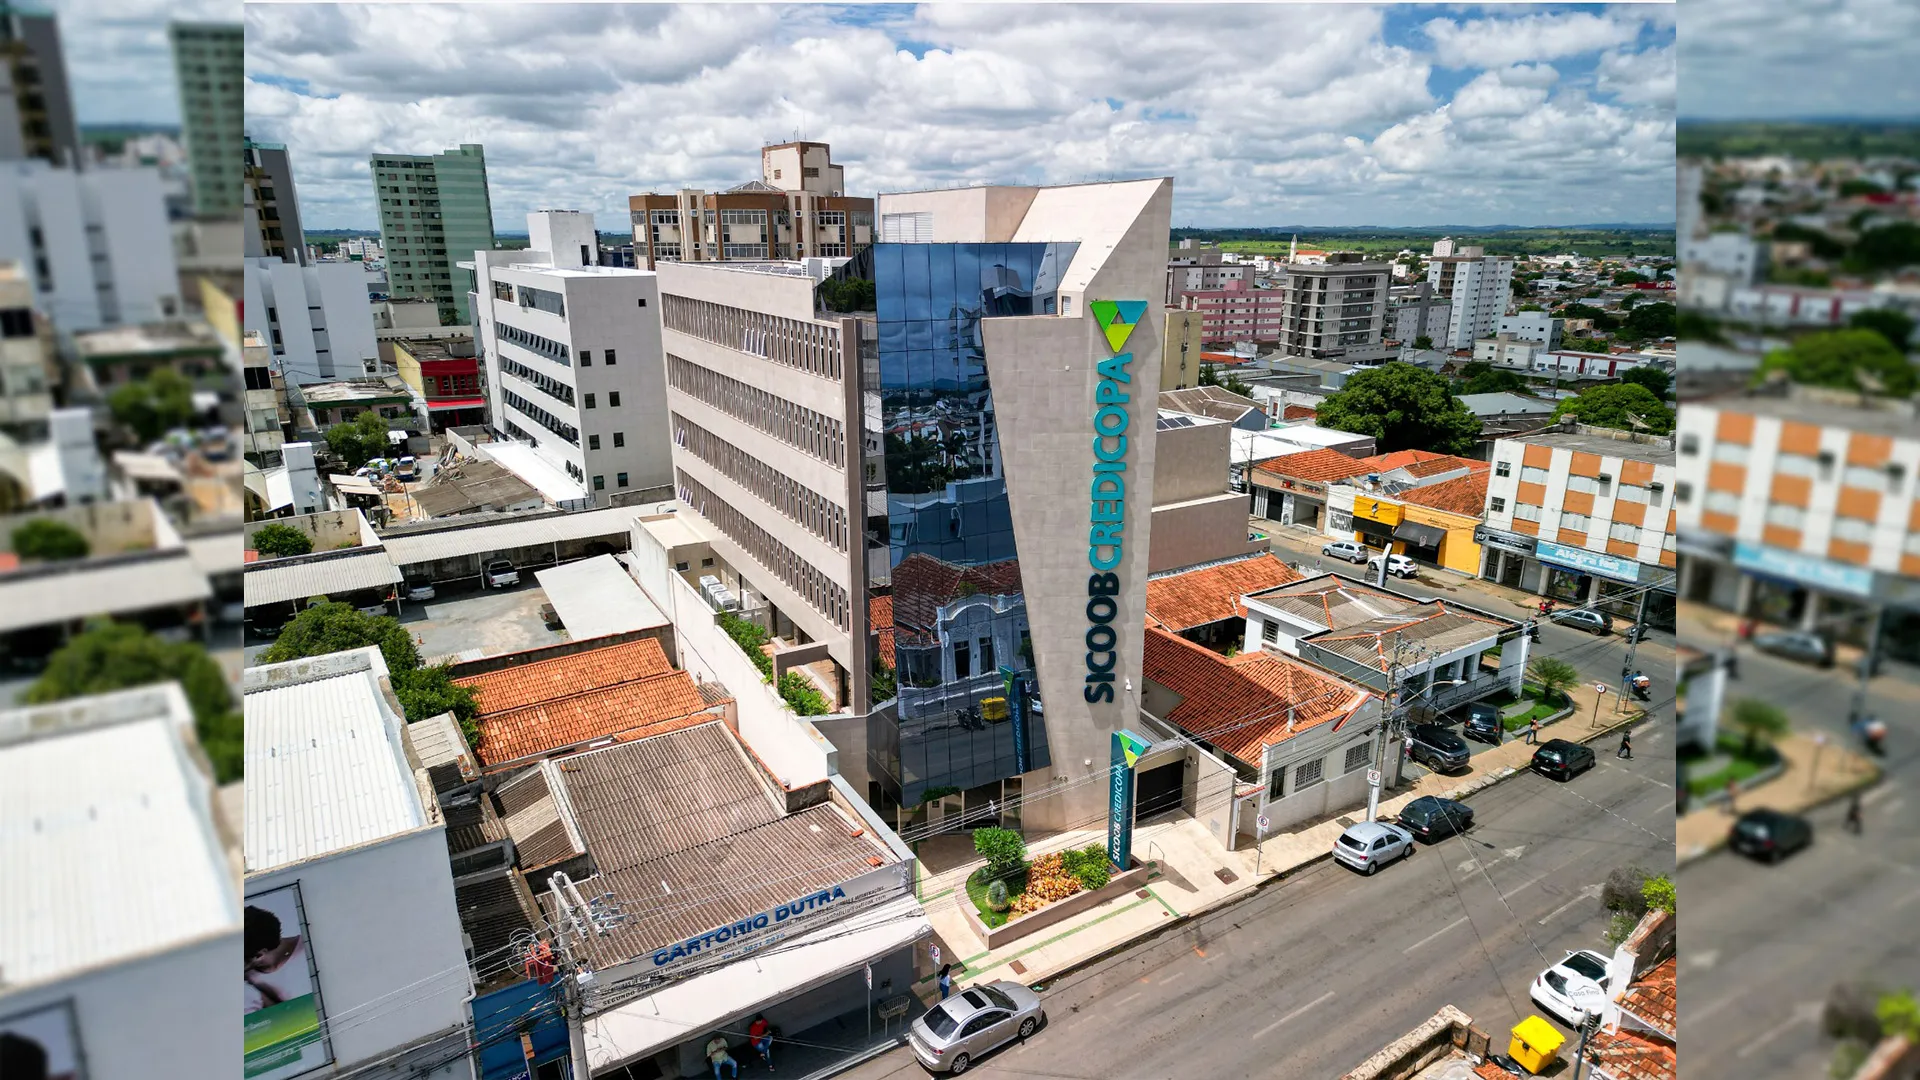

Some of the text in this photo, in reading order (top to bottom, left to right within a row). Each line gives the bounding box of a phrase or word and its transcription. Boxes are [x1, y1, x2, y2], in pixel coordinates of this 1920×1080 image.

[1084, 352, 1133, 704] SICOOB CREDICOPA
[1112, 764, 1123, 863] SICOOB CREDICOPA
[653, 885, 846, 966] CARTÓRIO DUTRA
[1568, 989, 1585, 997] Casa
